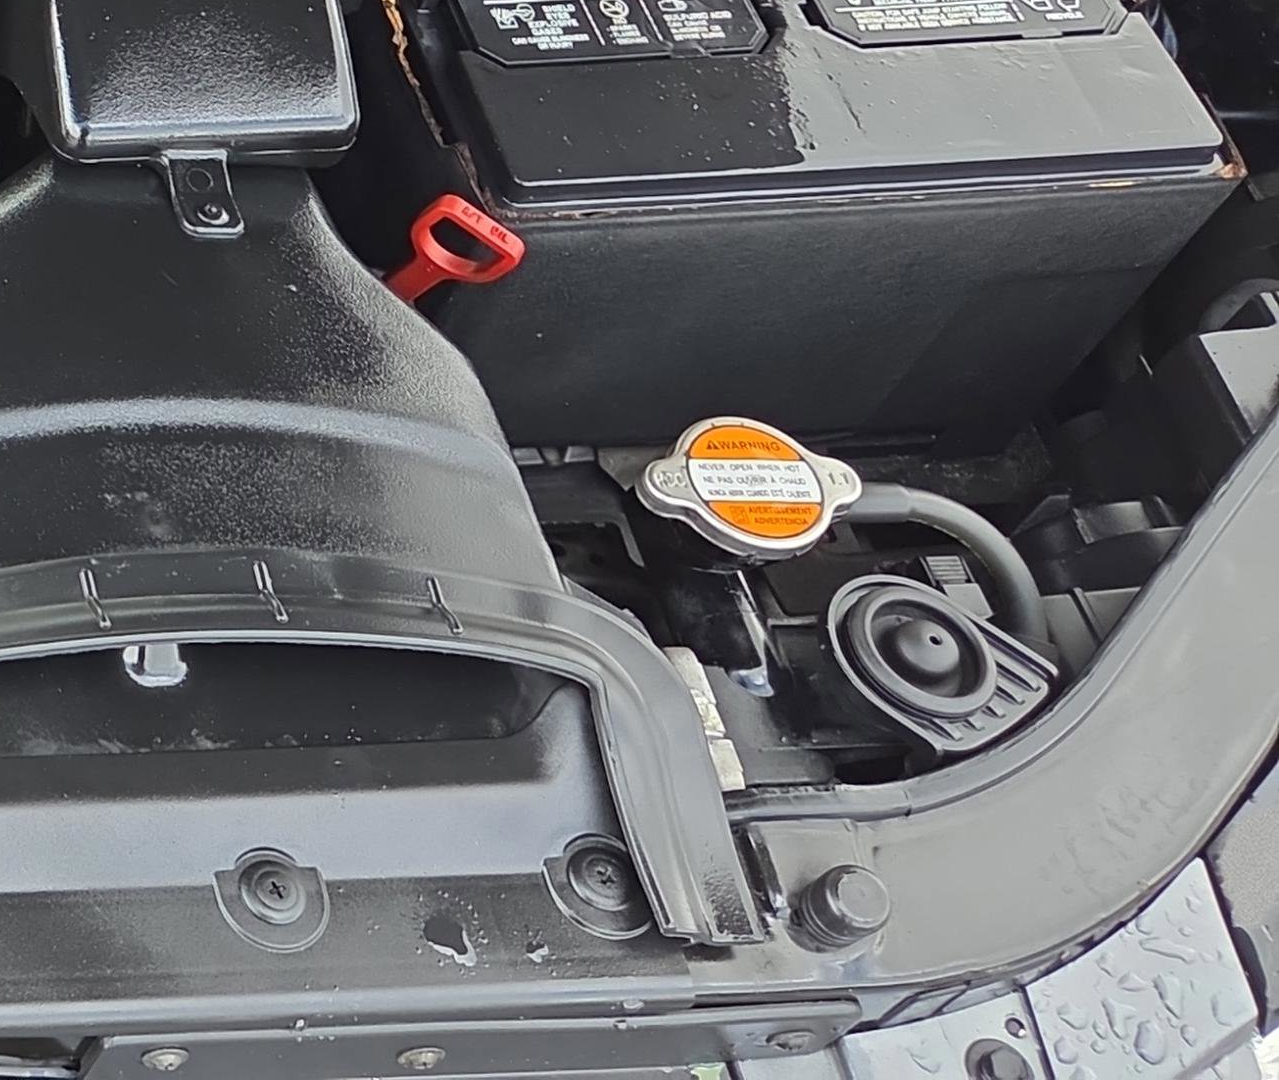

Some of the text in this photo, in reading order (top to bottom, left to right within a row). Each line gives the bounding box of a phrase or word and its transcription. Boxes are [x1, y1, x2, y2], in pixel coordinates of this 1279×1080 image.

[718, 440, 781, 452] WARNING
[698, 463, 800, 473] NEVER OPEN WHEN HOT
[703, 475, 715, 485] NE
[718, 476, 733, 485] PAS
[779, 476, 807, 486] CHAUD
